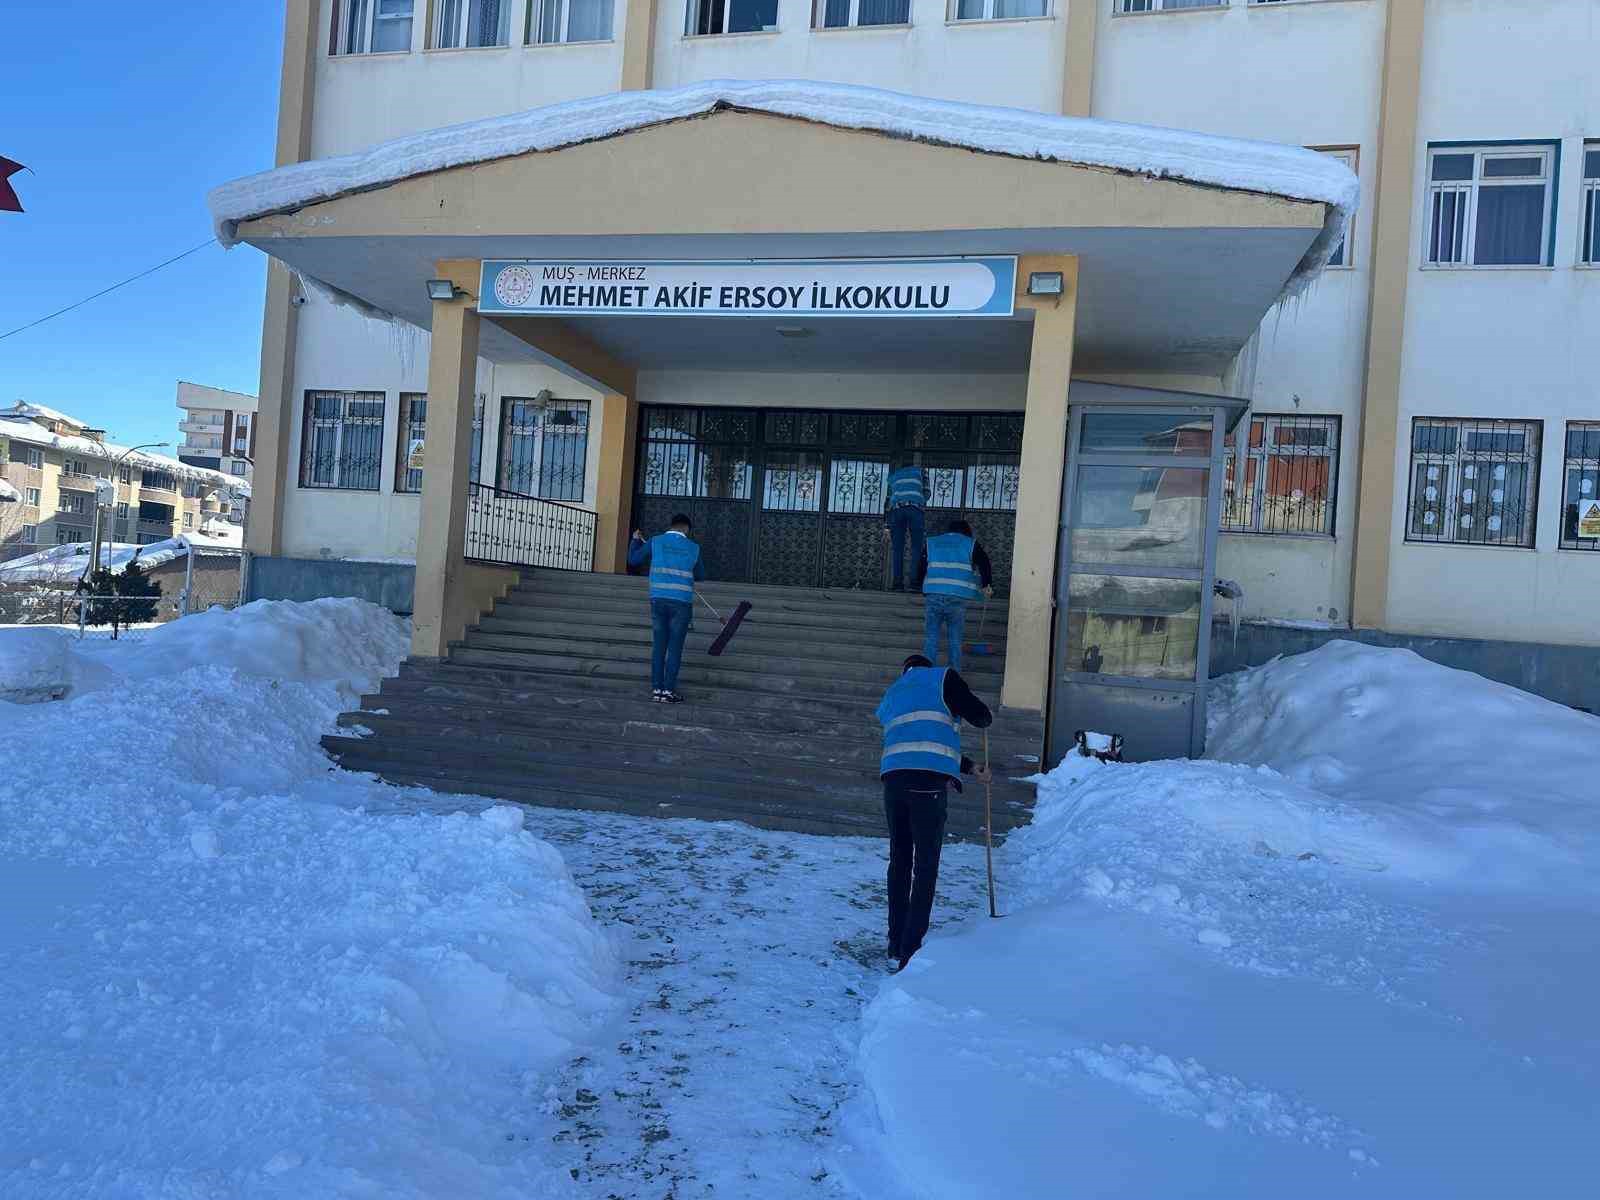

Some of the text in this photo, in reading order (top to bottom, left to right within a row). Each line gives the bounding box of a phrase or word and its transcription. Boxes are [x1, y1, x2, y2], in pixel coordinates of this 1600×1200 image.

[542, 267, 576, 283] MUŞ
[587, 267, 646, 281] MERKEZ
[540, 281, 950, 309] MEHMET AKİF ERSOY İLKOKULU
